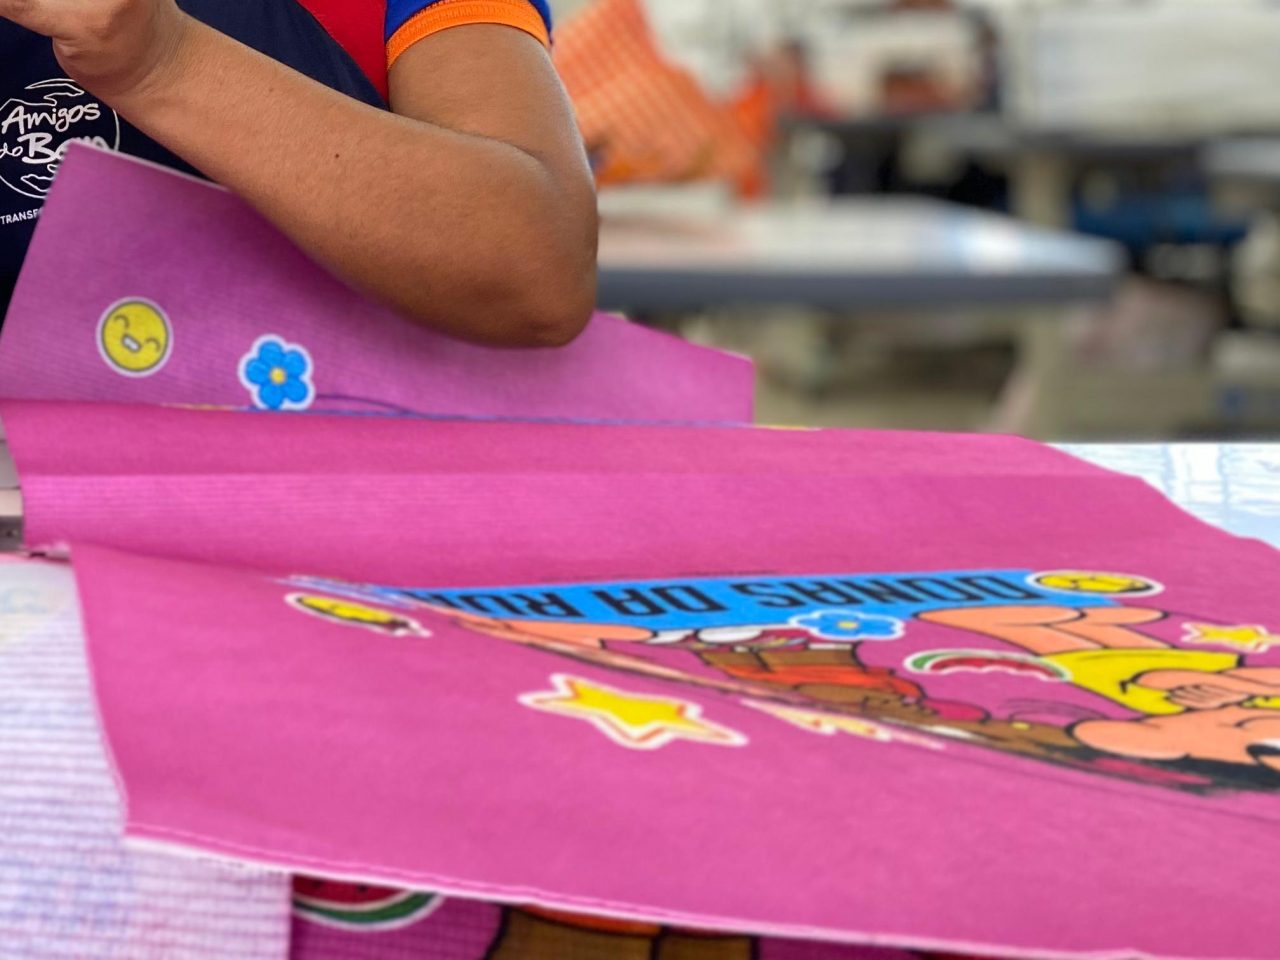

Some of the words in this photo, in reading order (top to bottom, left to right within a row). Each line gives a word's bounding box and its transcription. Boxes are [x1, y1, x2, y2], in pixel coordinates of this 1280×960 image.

[1, 103, 101, 134] Amigos
[592, 585, 729, 617] DA
[729, 576, 1048, 608] DONAS
